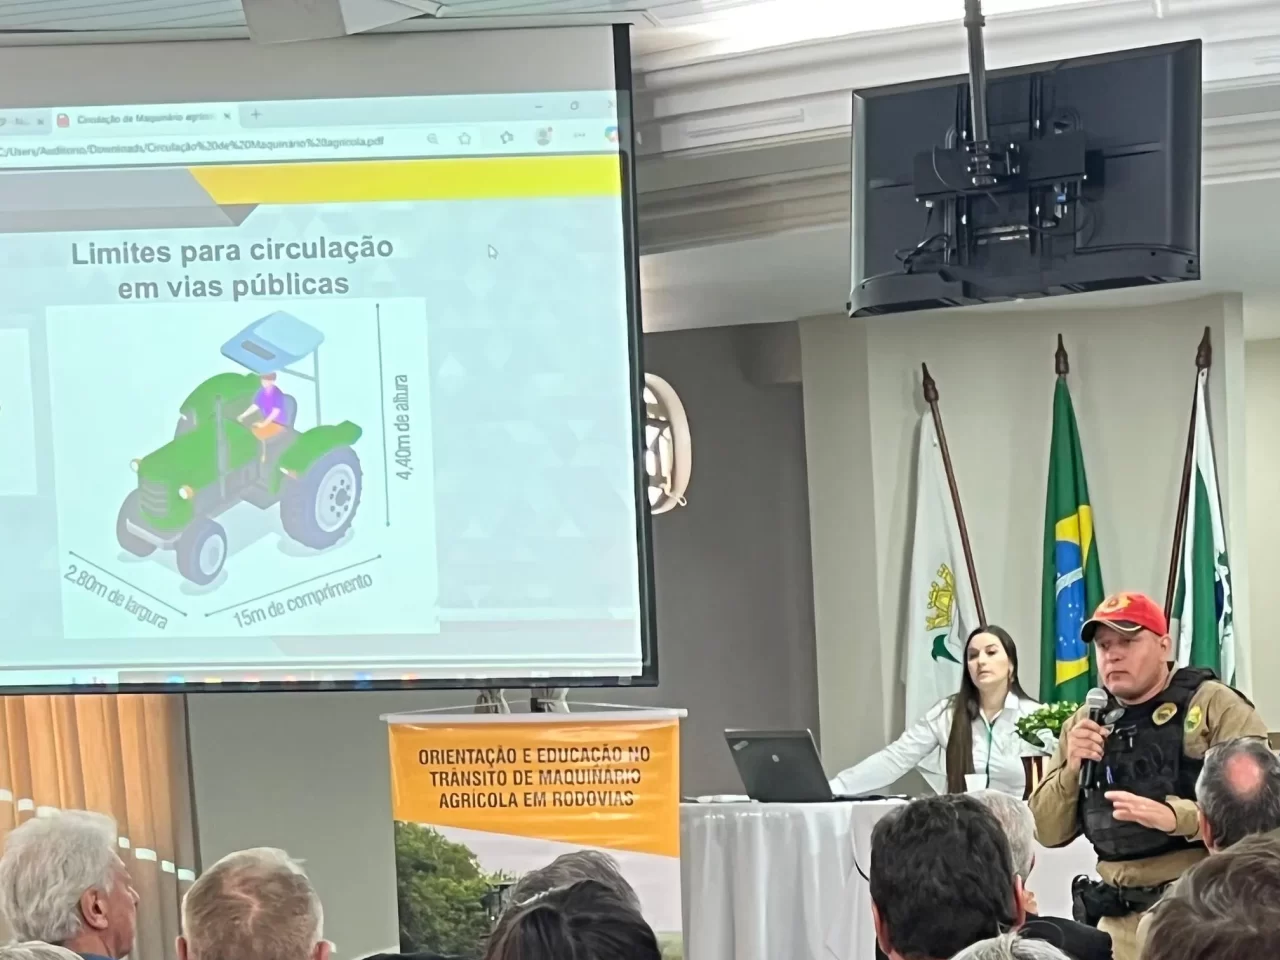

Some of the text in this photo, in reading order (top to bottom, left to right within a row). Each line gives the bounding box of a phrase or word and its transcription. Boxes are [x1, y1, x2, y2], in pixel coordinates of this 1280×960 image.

[72, 235, 394, 267] Limites para circulação
[118, 272, 349, 302] em vias públicas
[392, 374, 413, 480] 4,40m de altura
[108, 589, 123, 606] de
[124, 595, 168, 630] largura
[233, 574, 373, 628] 15m de comprimento
[419, 744, 650, 768] ORIENTAÇÃO E EDUCAÇÃO NO
[429, 765, 641, 787] TRÂNSITO DE MAQUINÁRIO
[440, 789, 634, 808] AGRÍCOLA EM RODOVIAS
